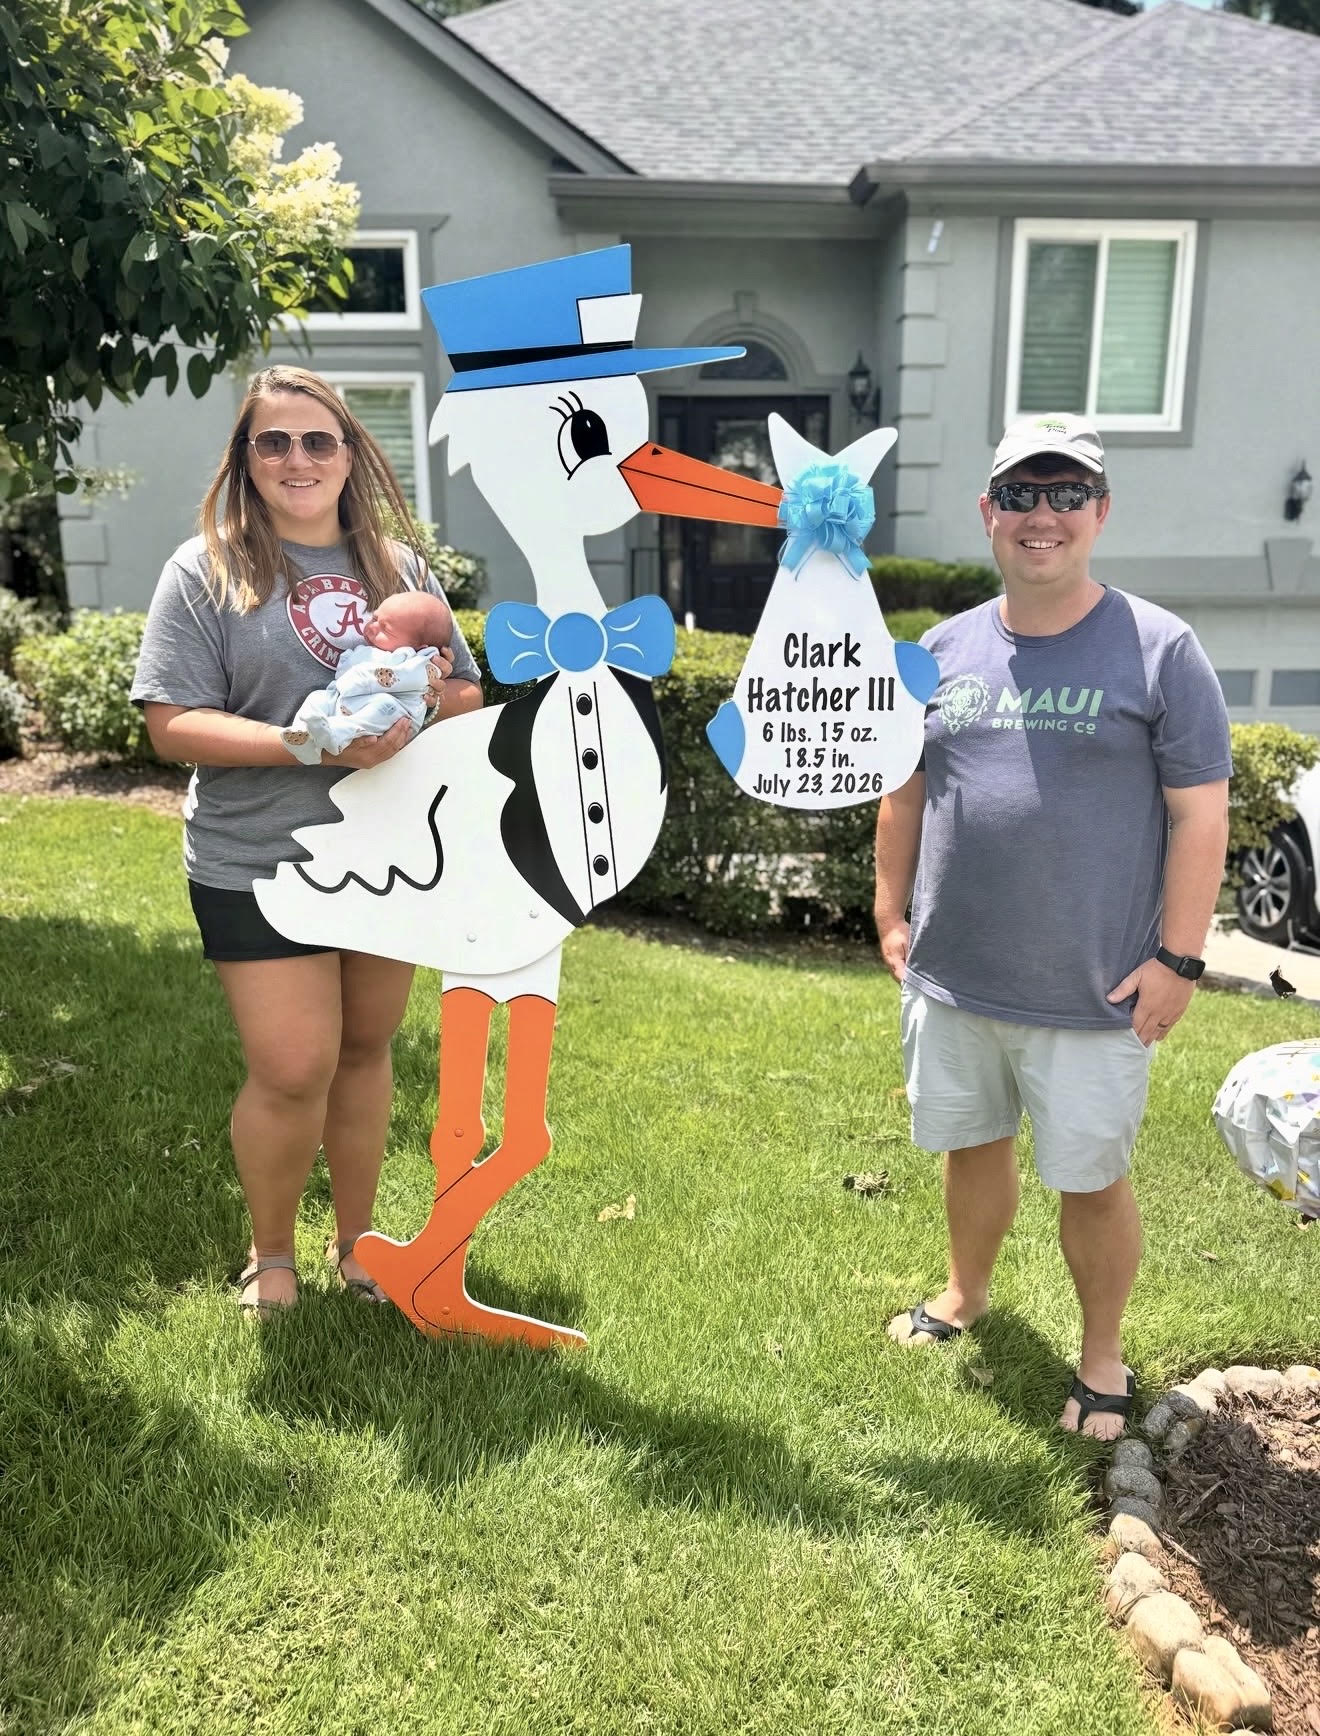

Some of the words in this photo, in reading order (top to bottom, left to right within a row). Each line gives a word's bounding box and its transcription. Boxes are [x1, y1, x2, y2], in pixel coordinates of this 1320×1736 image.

[292, 578, 368, 614] ALABA
[326, 601, 364, 638] A
[301, 626, 340, 665] CRIM
[784, 632, 862, 668] Clark
[748, 677, 860, 713] Hatcher
[867, 677, 895, 711] III
[996, 686, 1104, 717] MAUI
[762, 722, 774, 743] 6
[781, 722, 812, 743] lbs.
[820, 722, 845, 743] 15
[850, 728, 878, 743] oz.
[992, 718, 1067, 732] BREWING
[785, 748, 826, 769] 18.5
[832, 749, 855, 769] in.
[753, 773, 791, 798] July
[796, 774, 824, 796] 23,
[830, 772, 883, 794] 2026
